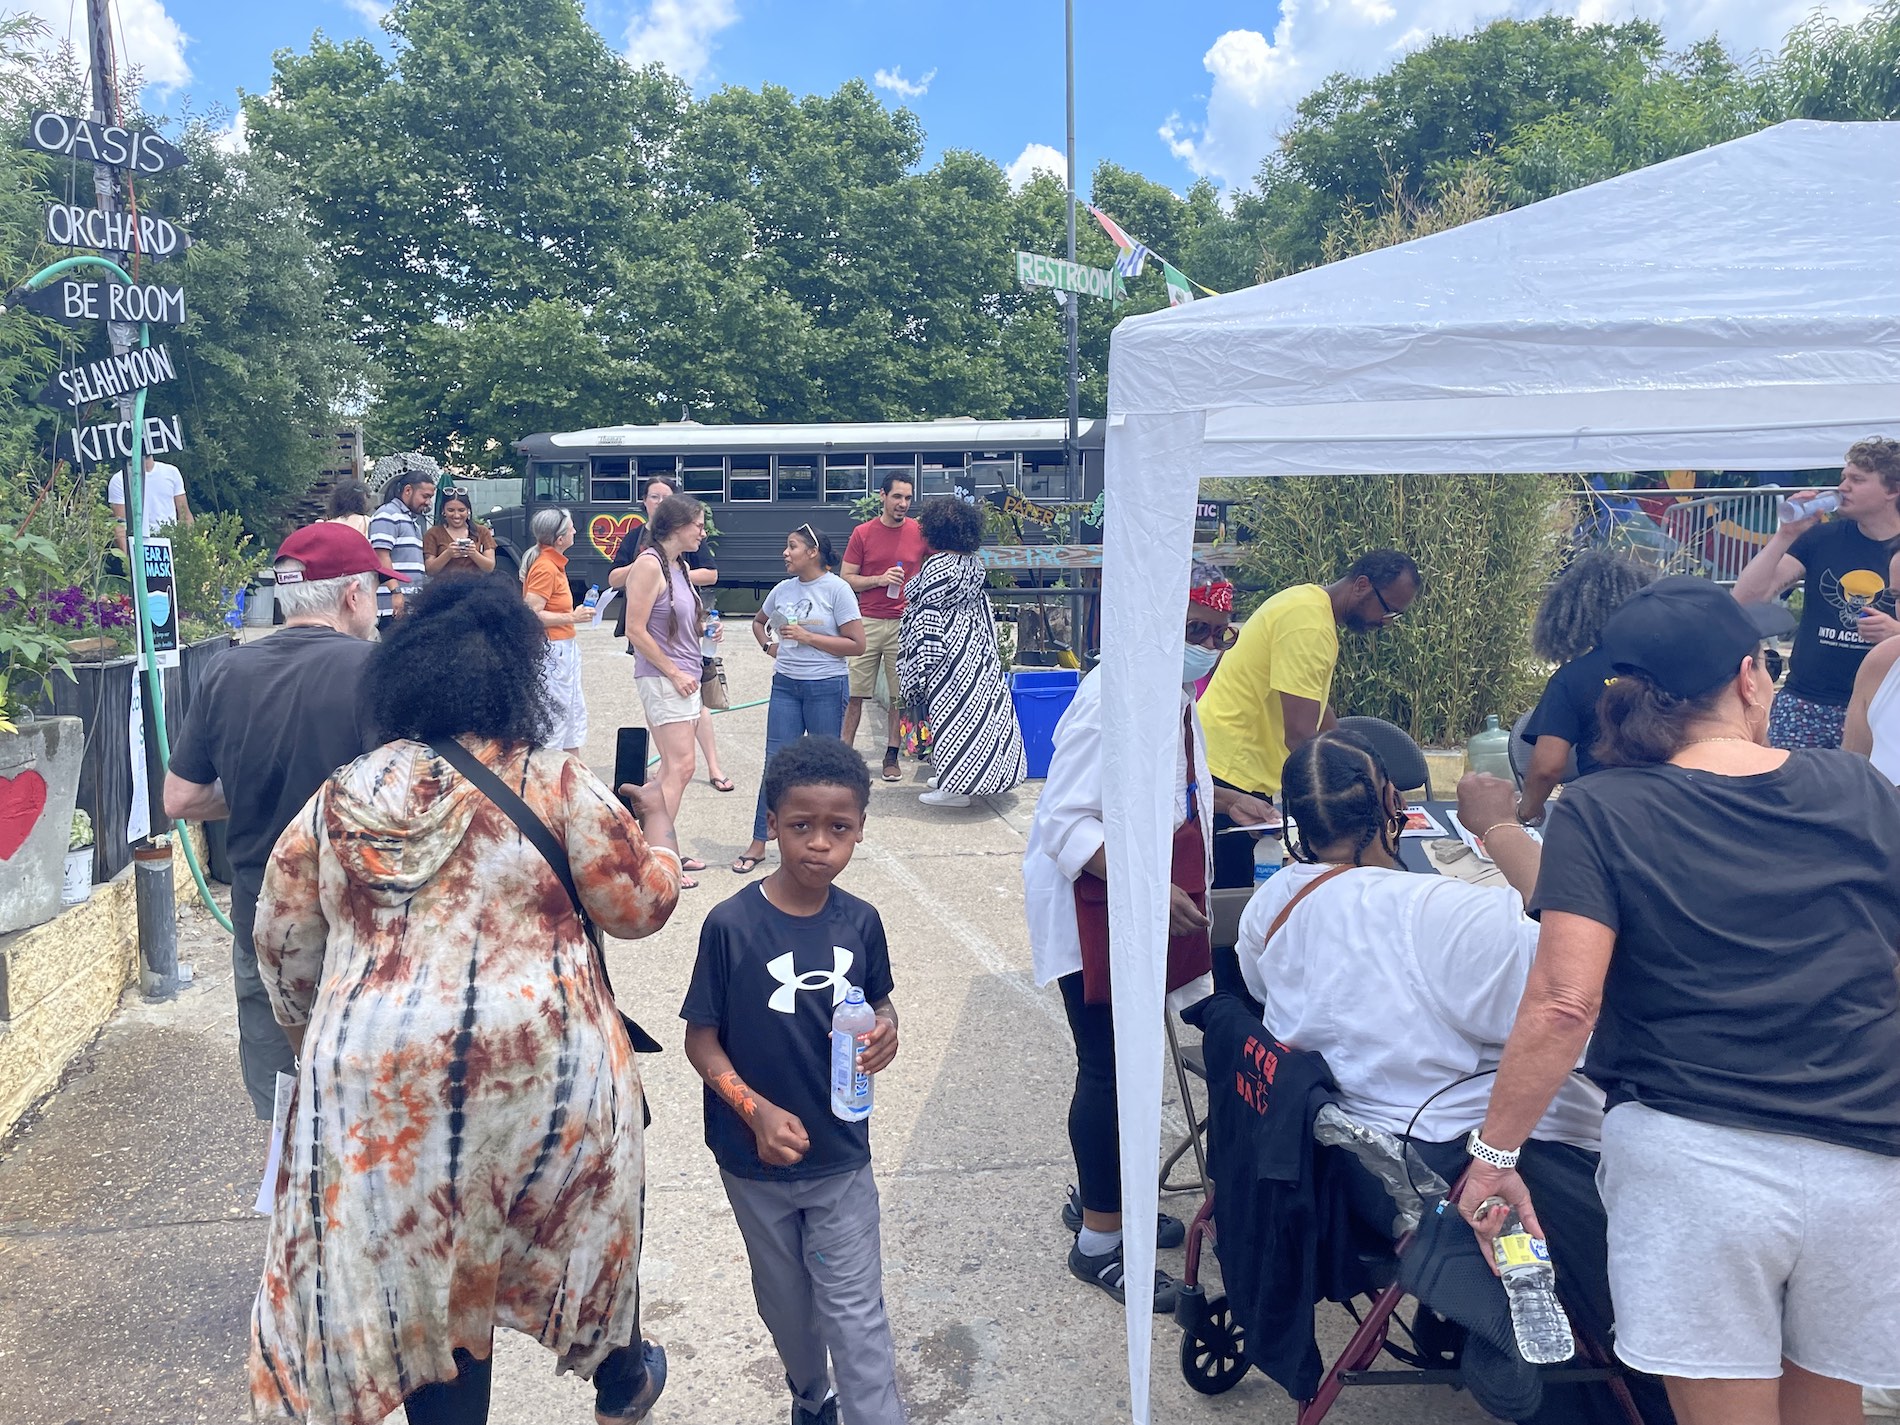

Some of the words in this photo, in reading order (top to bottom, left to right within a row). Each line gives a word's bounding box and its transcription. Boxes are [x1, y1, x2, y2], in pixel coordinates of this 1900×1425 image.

[34, 113, 165, 173] OASIS
[48, 203, 177, 254] ORCHARD
[1019, 251, 1113, 300] RESTROOM
[63, 281, 99, 319] BE
[109, 283, 185, 323] ROOM
[1004, 495, 1053, 528] PAPER
[1197, 504, 1217, 517] TIC
[144, 547, 161, 561] EAR
[146, 562, 171, 577] MASK
[1818, 626, 1836, 639] INTO
